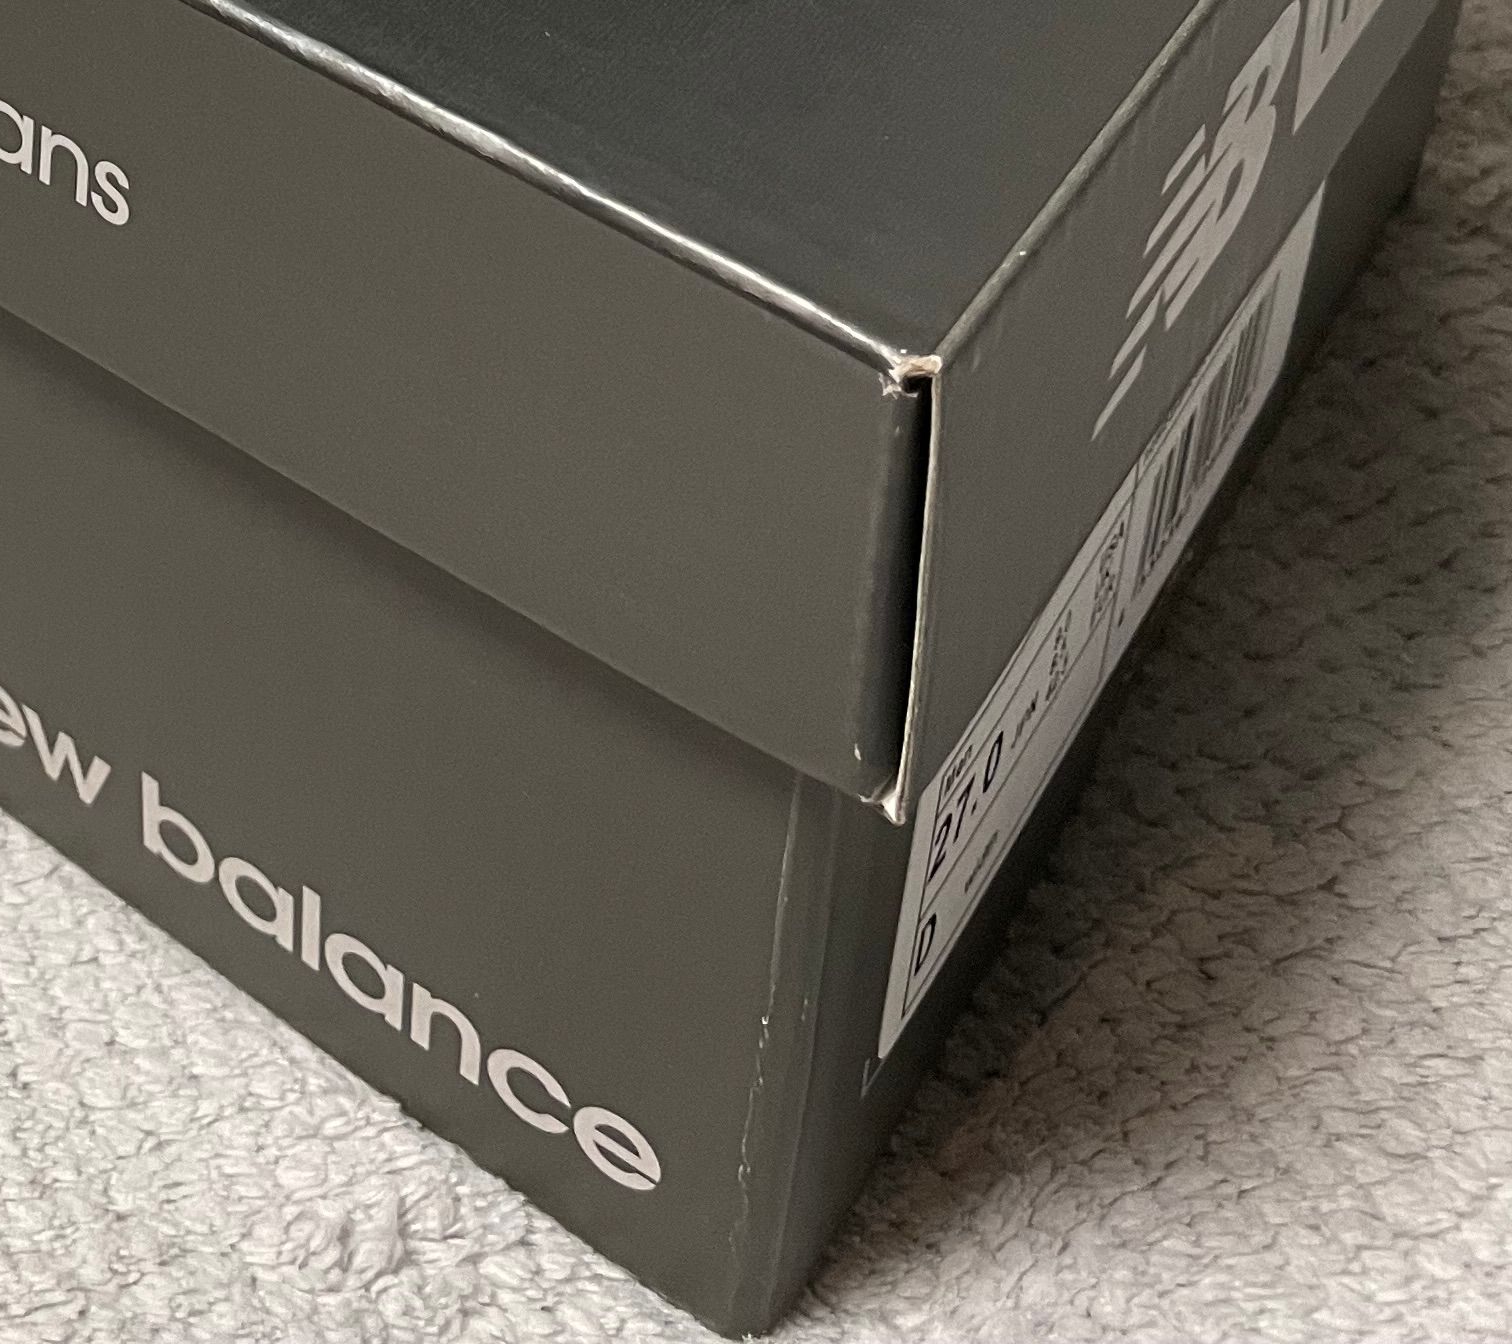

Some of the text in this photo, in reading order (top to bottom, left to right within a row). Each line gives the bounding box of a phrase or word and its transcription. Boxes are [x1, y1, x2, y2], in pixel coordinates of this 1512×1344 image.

[927, 728, 1005, 884] 27.0
[140, 770, 663, 1192] balance
[913, 912, 938, 978] D
